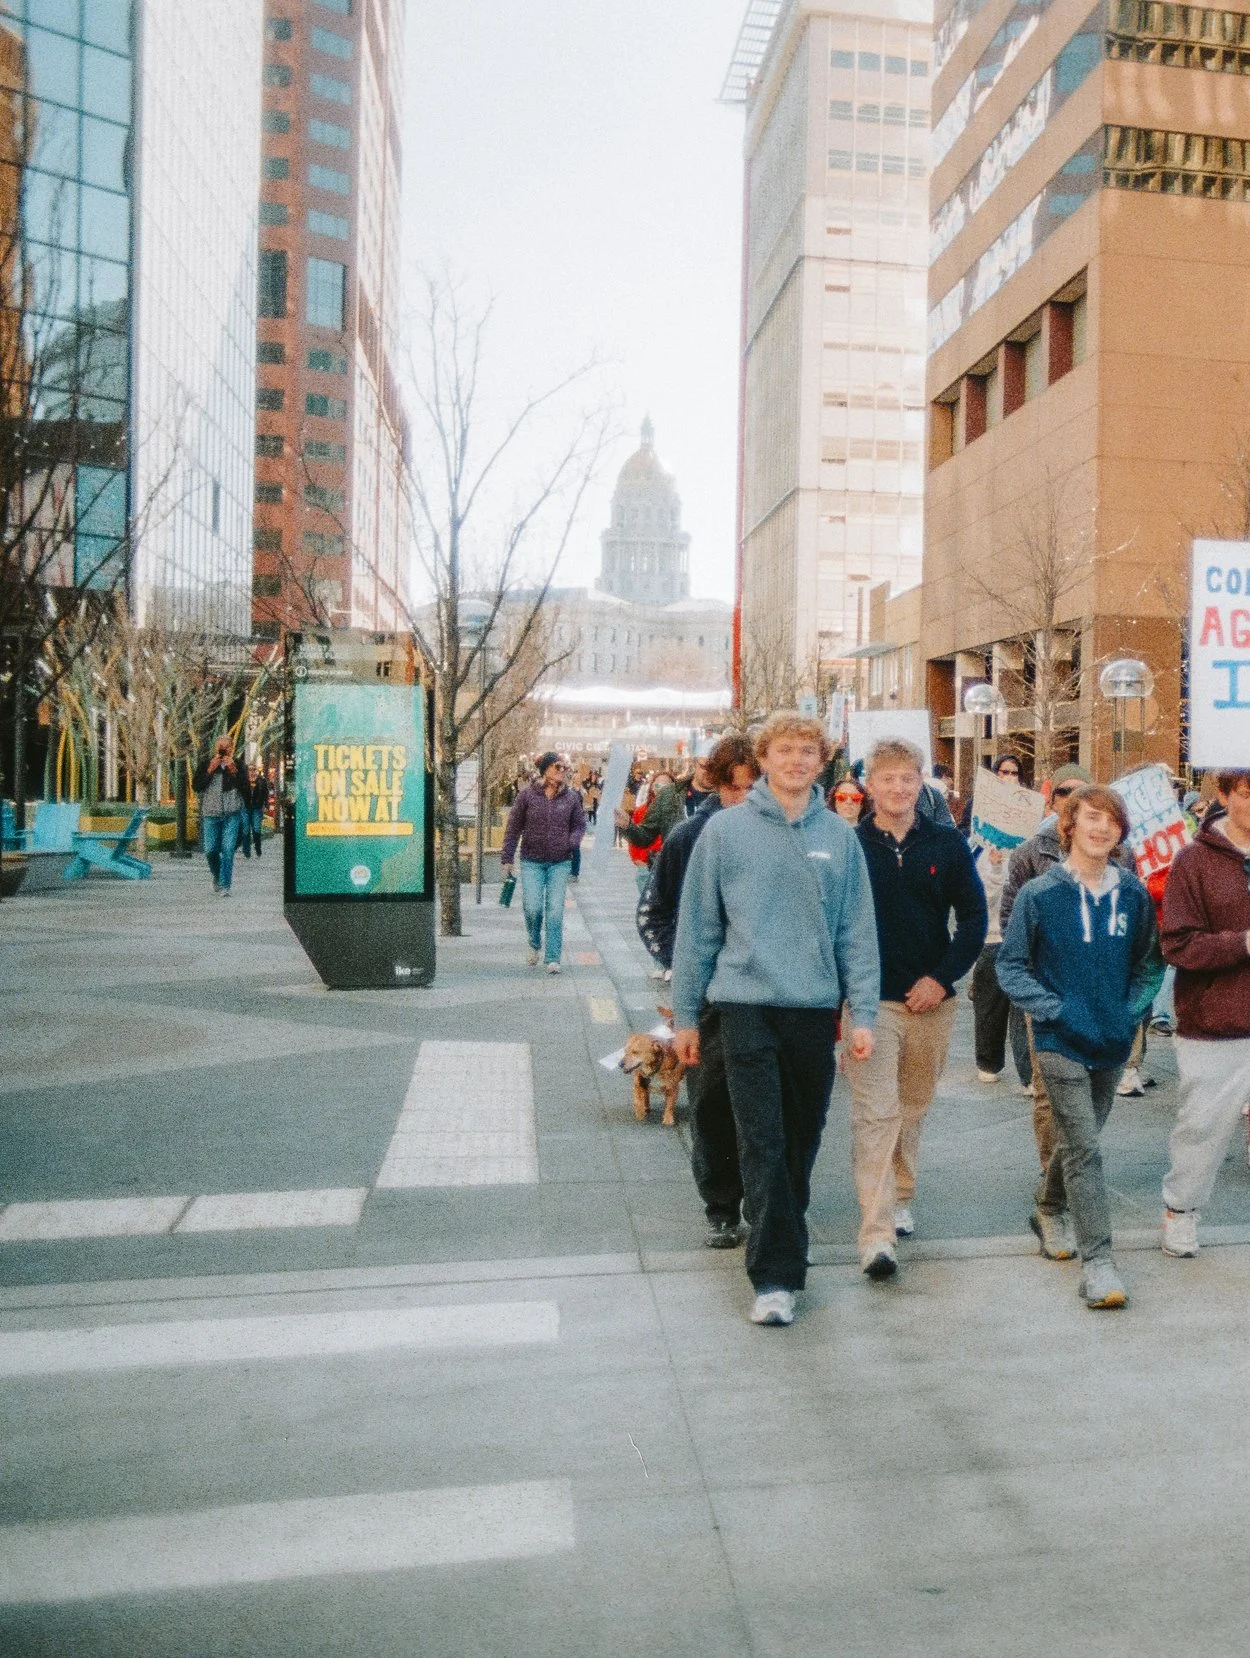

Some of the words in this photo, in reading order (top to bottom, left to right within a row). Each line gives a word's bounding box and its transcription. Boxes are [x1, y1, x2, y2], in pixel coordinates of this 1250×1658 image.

[314, 745, 407, 770] TICKETS
[315, 770, 347, 796] ON
[351, 770, 404, 796] SALE
[318, 796, 371, 822] NOW
[375, 796, 402, 822] AT
[1136, 820, 1185, 878] HOT
